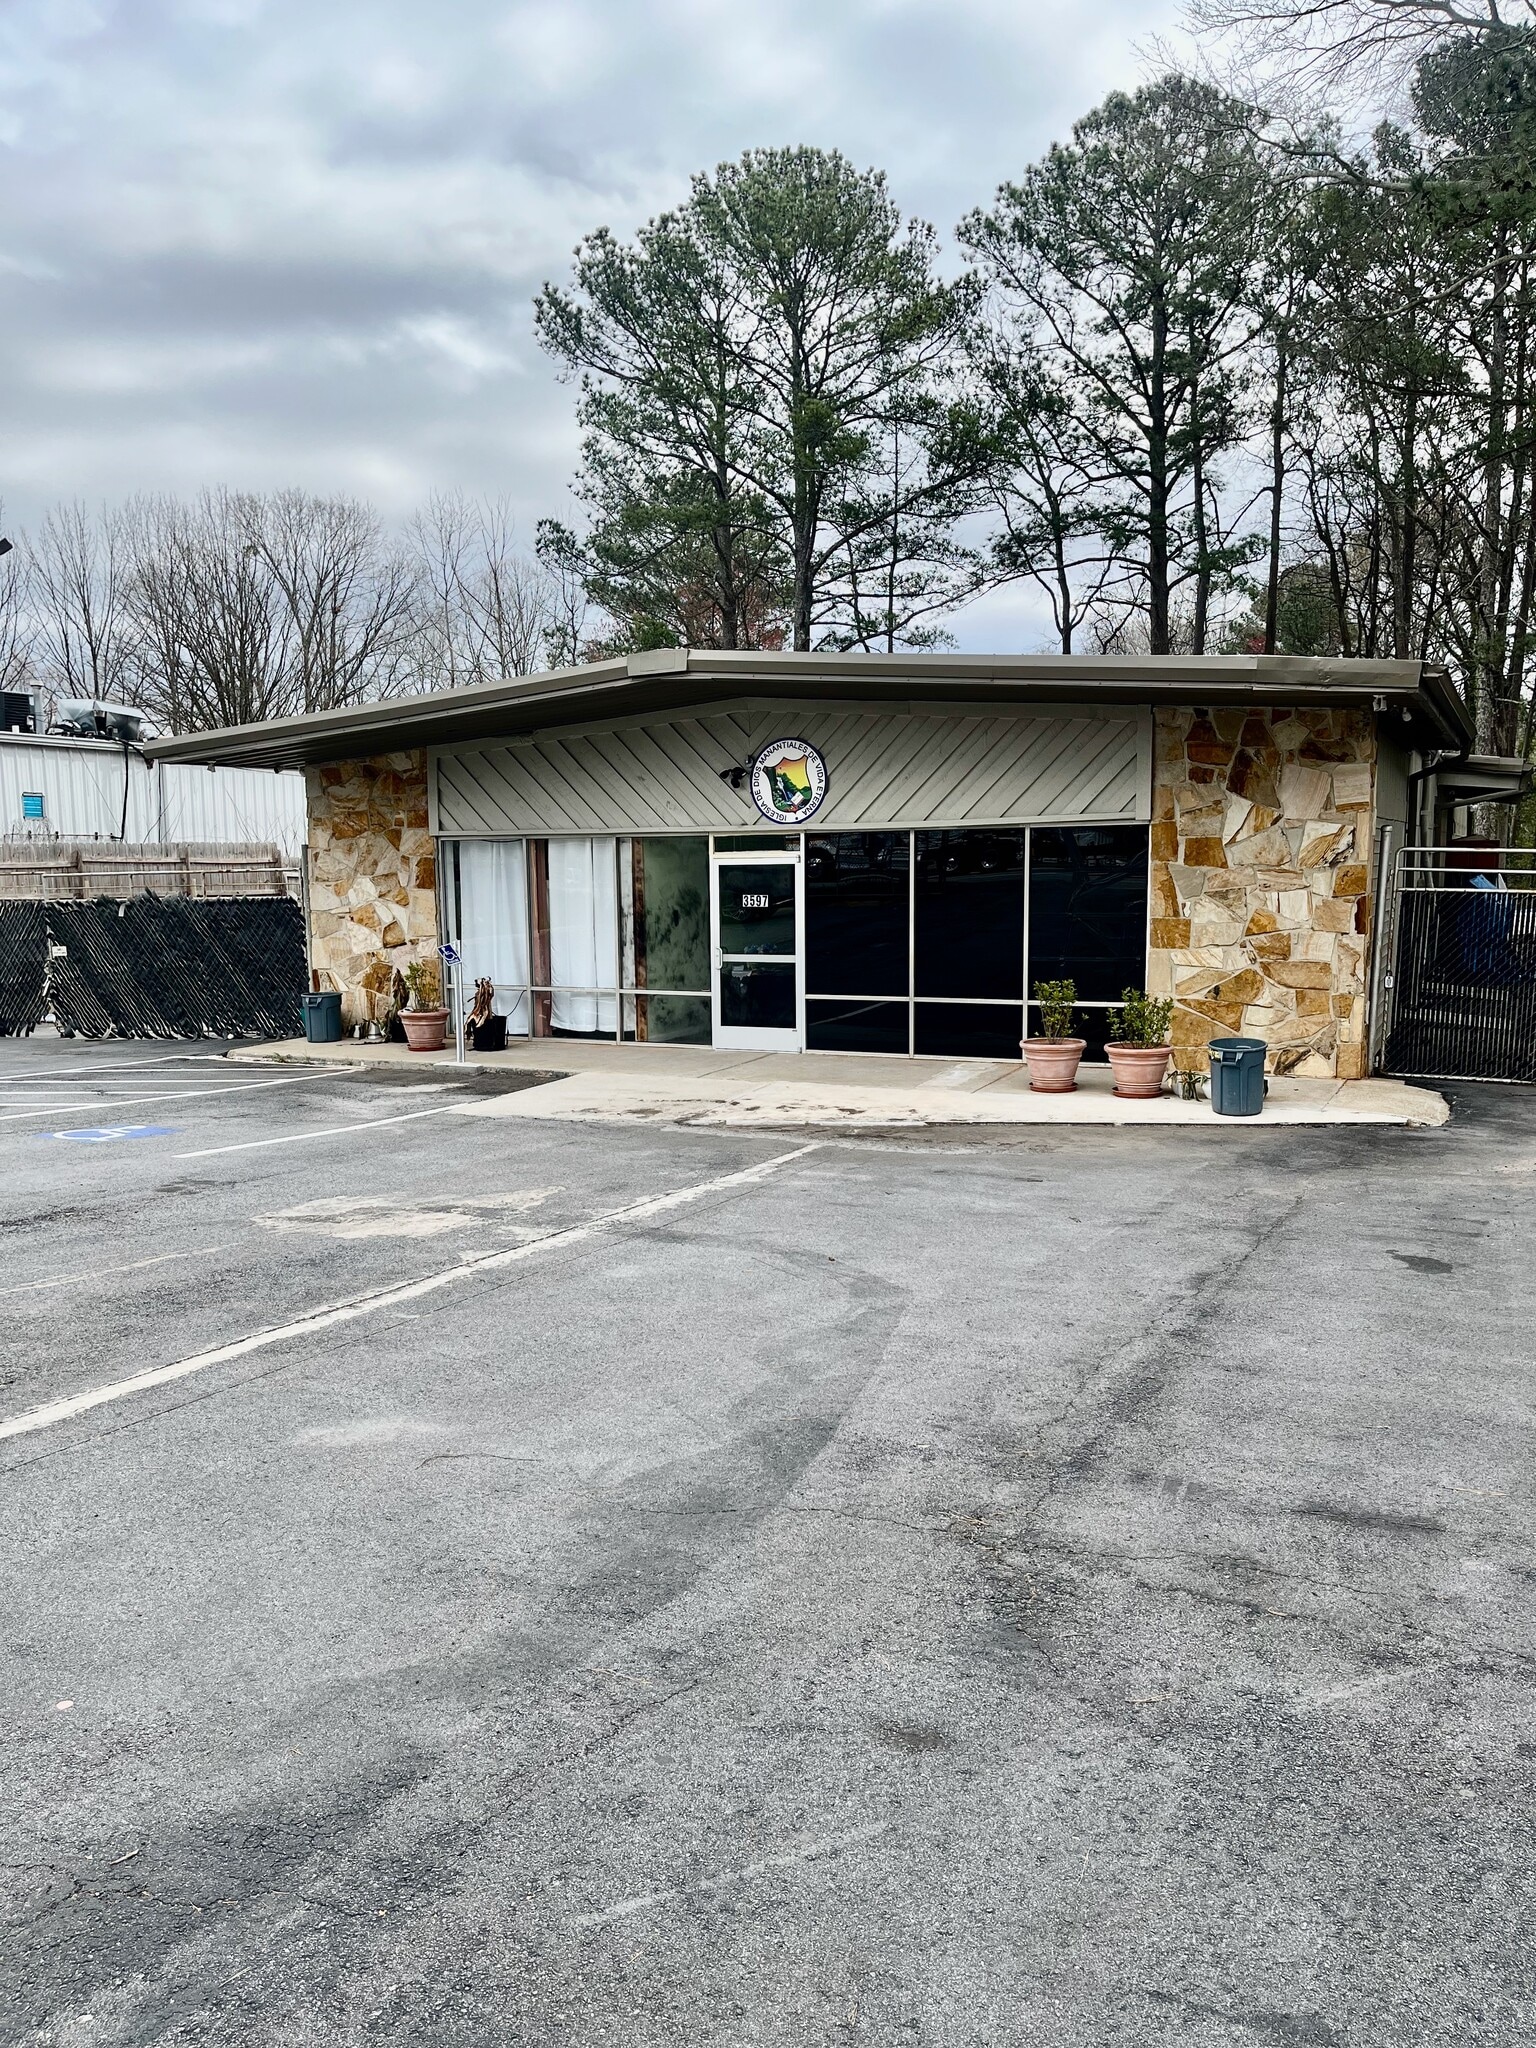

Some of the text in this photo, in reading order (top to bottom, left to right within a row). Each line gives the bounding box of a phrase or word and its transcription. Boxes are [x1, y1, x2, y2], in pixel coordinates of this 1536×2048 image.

[754, 741, 824, 821] IGLESIA DE DIOS MANANTIALES DE VIDA ETERNA
[743, 895, 768, 907] 3597
